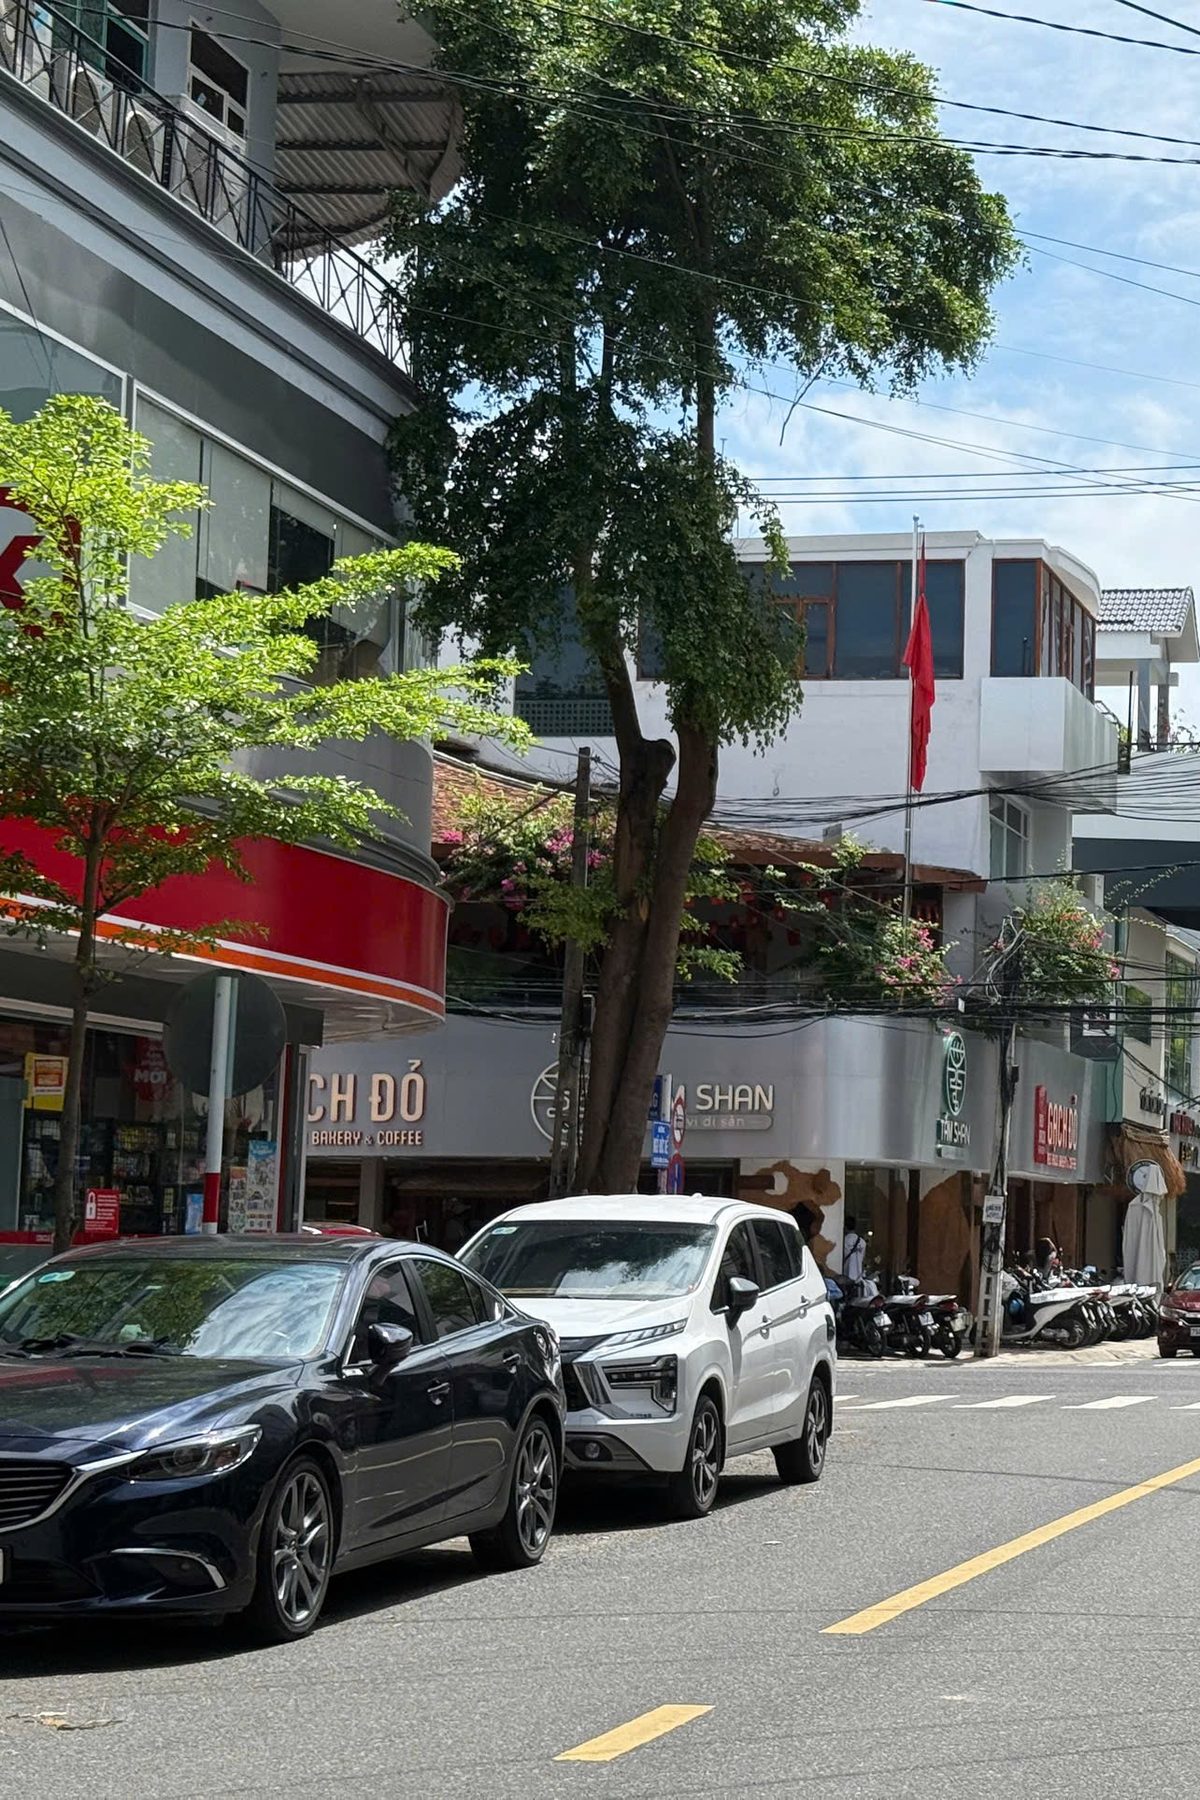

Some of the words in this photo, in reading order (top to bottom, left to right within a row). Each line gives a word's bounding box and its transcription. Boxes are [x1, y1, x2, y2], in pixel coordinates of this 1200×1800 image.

[368, 1059, 424, 1122] ĐỎ
[696, 1084, 774, 1111] SHAN
[312, 1130, 361, 1145] BAKERY
[365, 1135, 373, 1145] &
[377, 1130, 422, 1145] COFFEE
